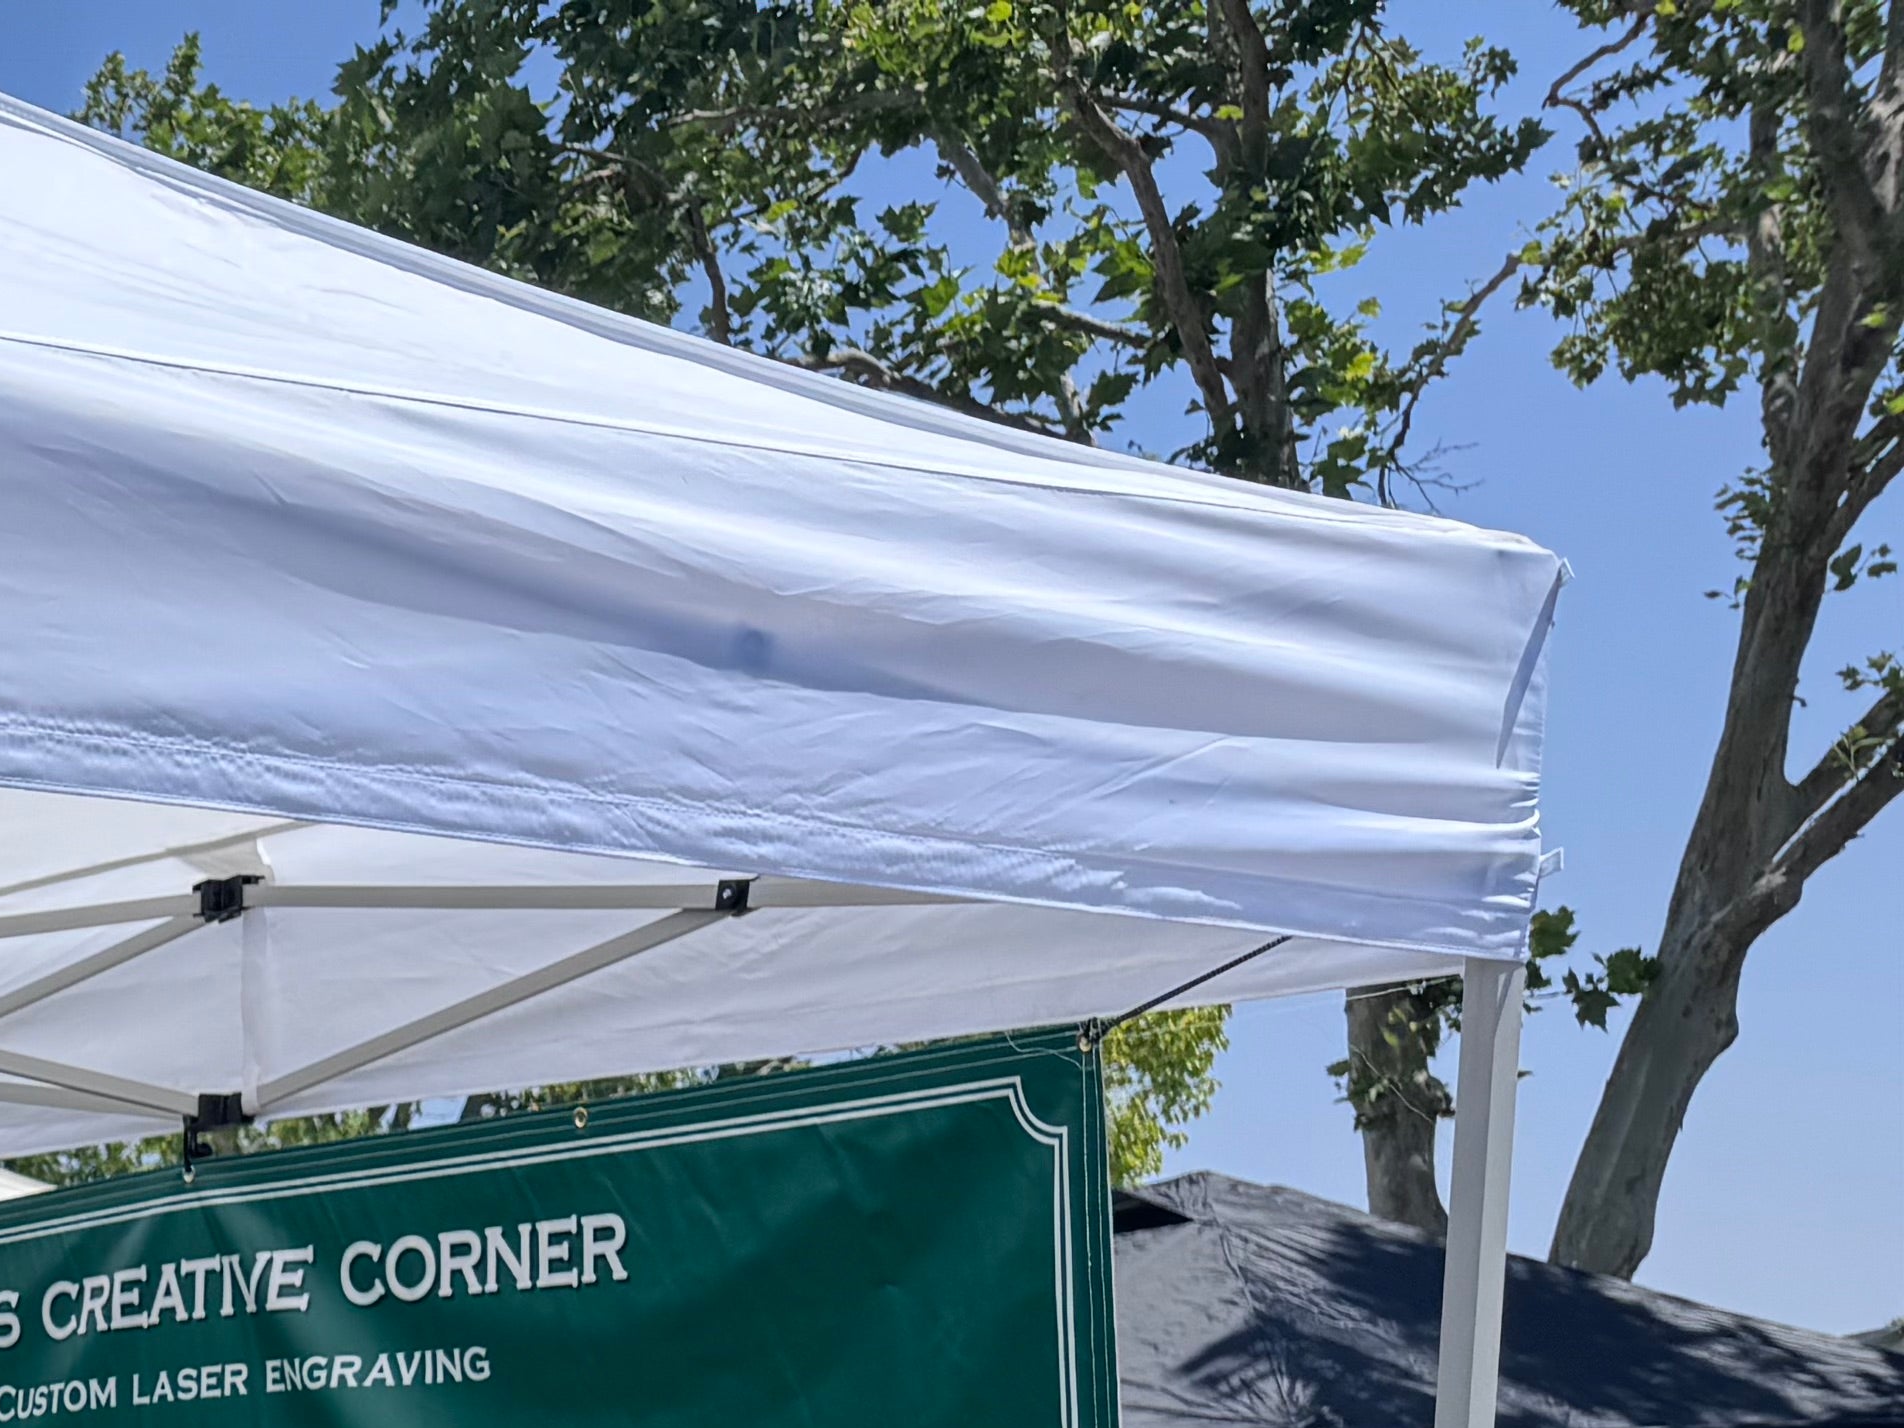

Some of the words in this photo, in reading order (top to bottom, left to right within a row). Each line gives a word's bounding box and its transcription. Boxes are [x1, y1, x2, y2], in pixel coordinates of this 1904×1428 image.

[41, 1244, 314, 1340] CREATIVE
[340, 1212, 629, 1306] CORNER
[132, 1362, 249, 1406] LASER
[265, 1346, 491, 1393] ENGRAVING
